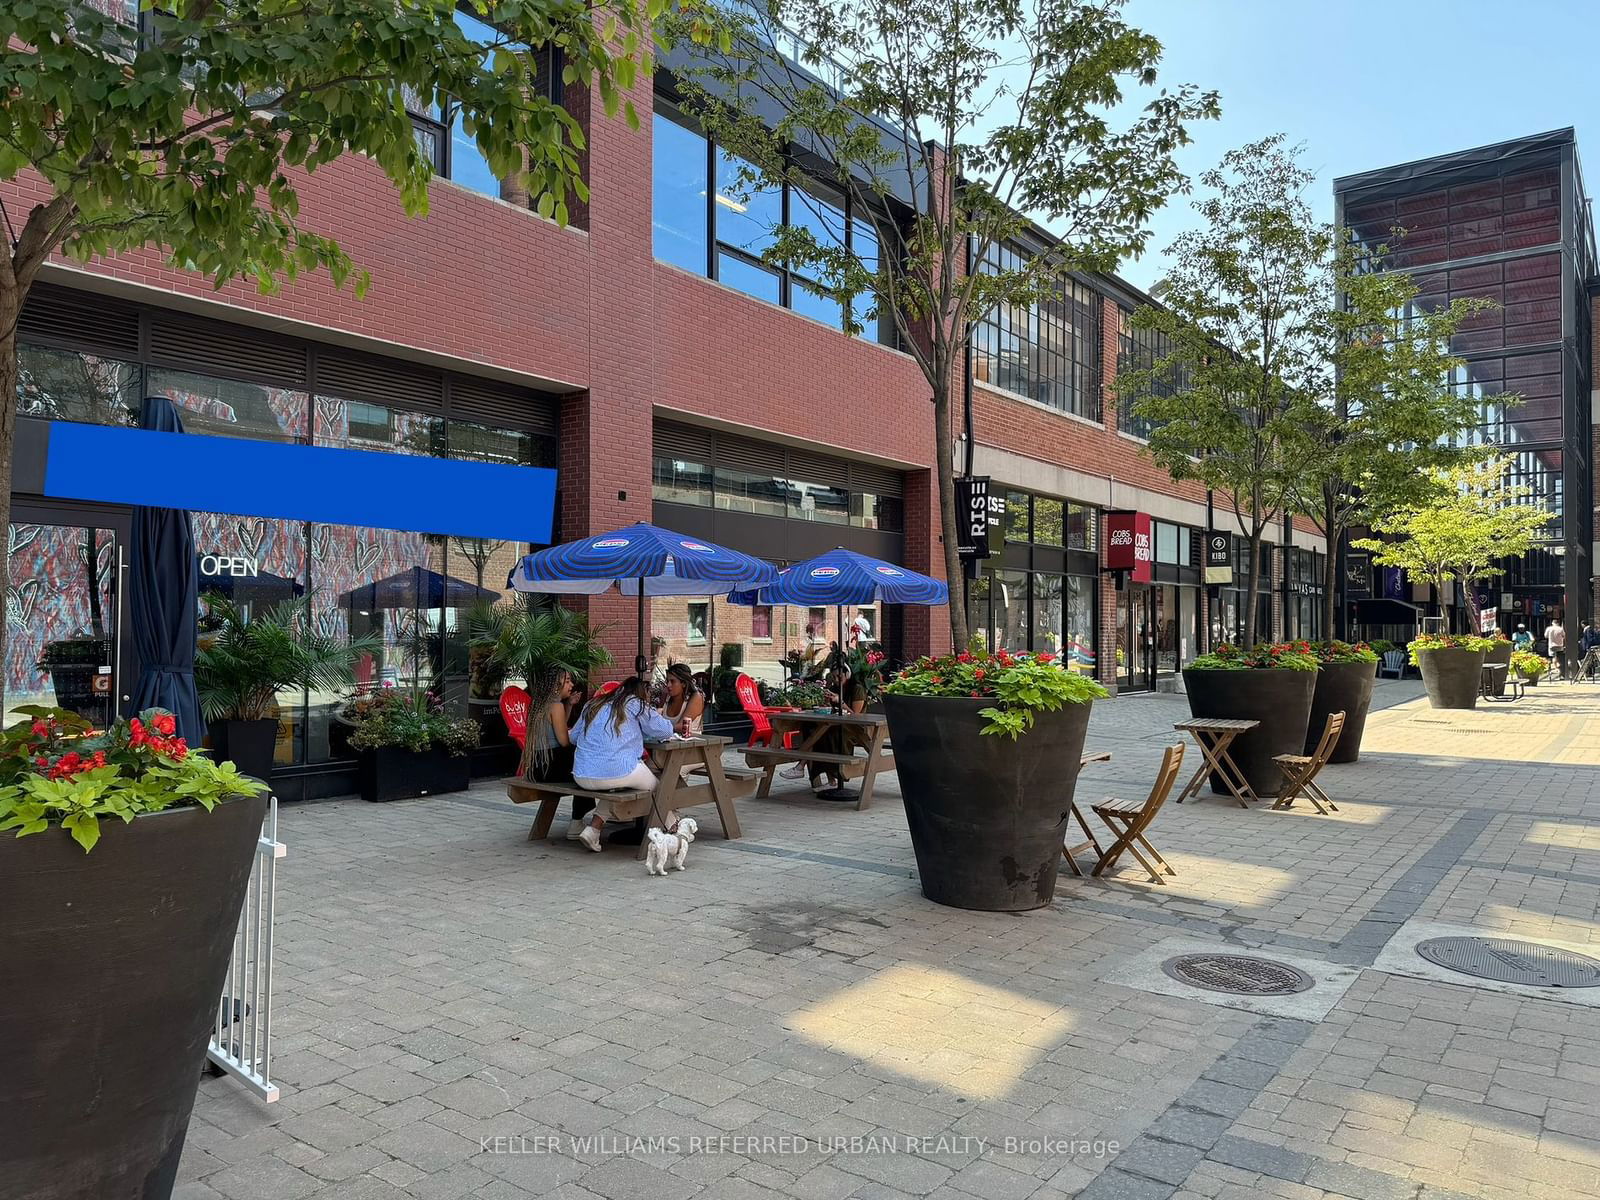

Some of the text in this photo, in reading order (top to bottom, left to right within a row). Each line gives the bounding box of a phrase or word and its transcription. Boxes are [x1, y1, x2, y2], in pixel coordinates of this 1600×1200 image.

[971, 482, 986, 536] RISE
[988, 496, 1005, 513] ISE
[1112, 529, 1130, 538] COBS
[1135, 533, 1149, 548] COBS
[1110, 537, 1132, 546] BREAD
[1211, 552, 1227, 560] KIBO
[200, 555, 258, 577] OPEN
[94, 676, 109, 690] G
